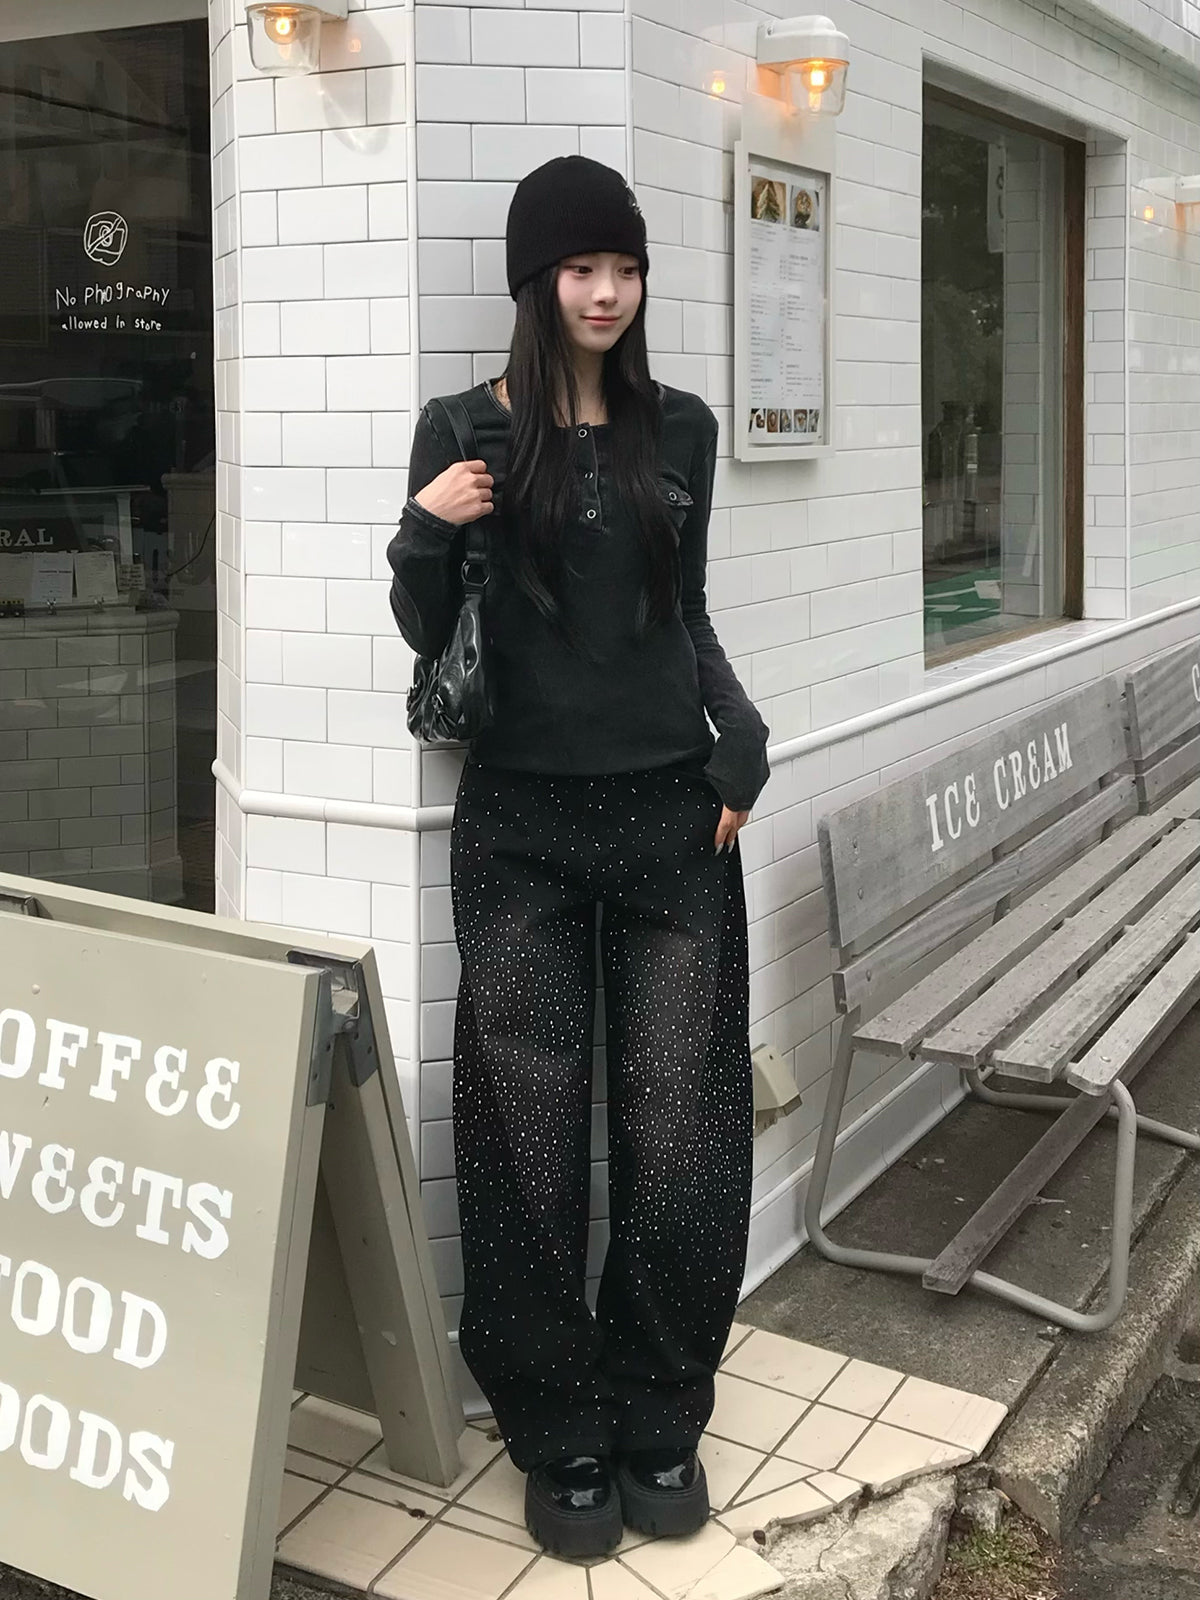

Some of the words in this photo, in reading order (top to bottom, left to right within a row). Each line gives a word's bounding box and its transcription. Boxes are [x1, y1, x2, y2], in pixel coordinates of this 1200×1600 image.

[56, 287, 77, 310] No
[61, 316, 107, 330] allowed
[134, 319, 162, 331] store
[926, 772, 980, 851] ICE
[993, 722, 1073, 810] CREAM
[0, 1254, 167, 1369] OOD
